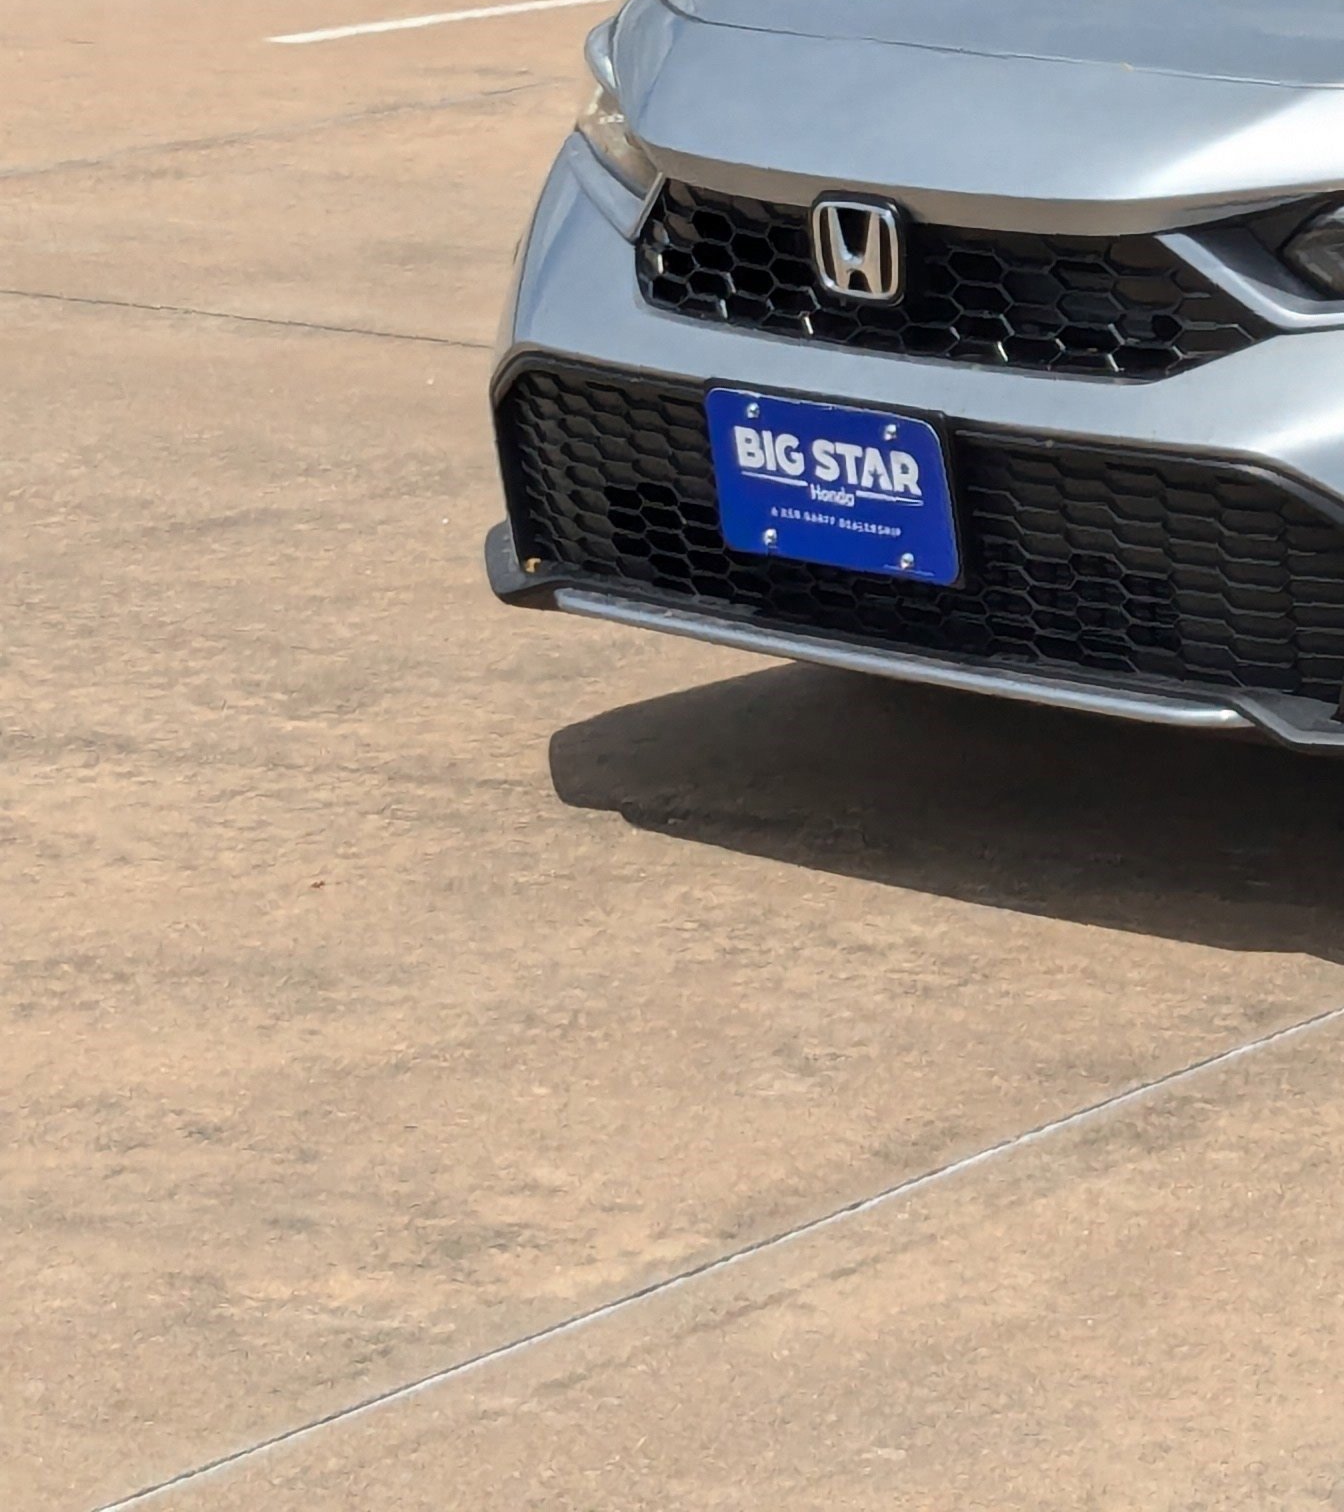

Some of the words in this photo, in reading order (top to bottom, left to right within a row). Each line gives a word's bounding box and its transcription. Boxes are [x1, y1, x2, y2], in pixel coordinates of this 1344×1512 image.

[733, 425, 805, 477] BIG
[811, 437, 923, 497] STAR
[809, 483, 856, 509] Honda
